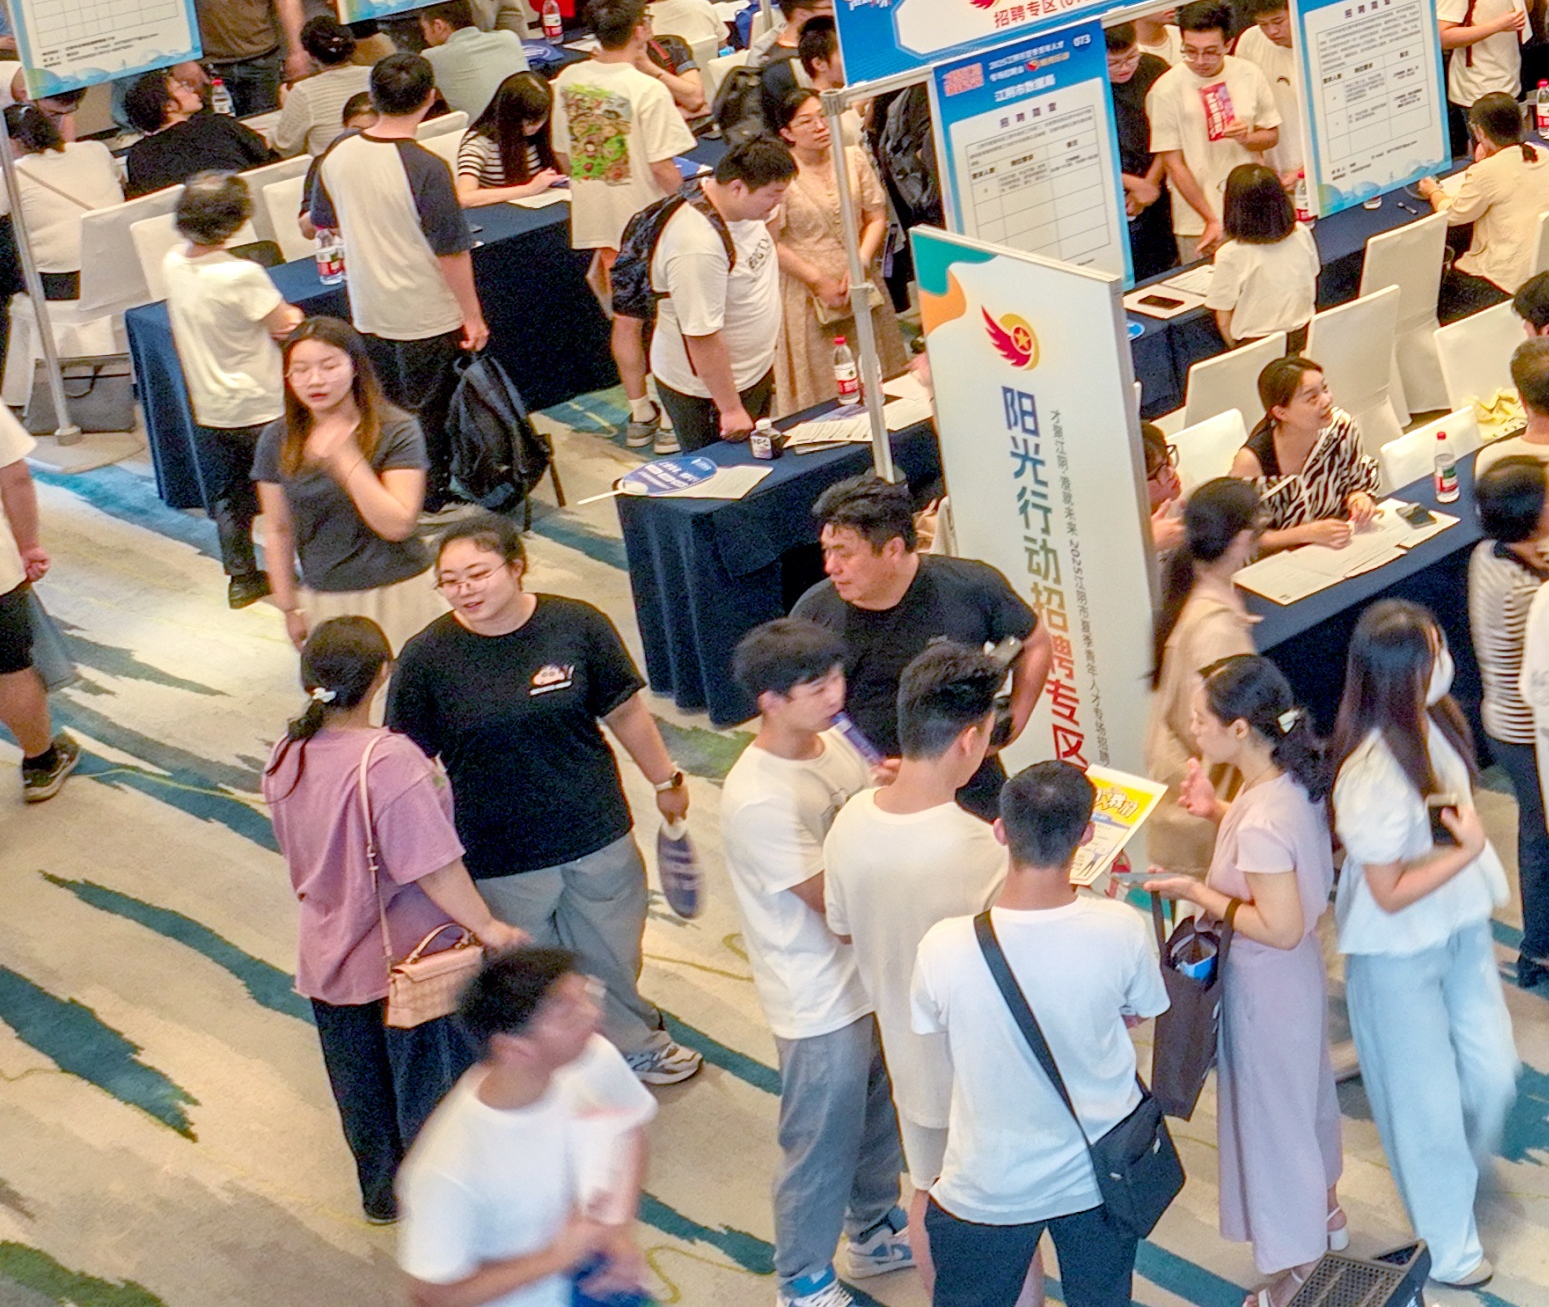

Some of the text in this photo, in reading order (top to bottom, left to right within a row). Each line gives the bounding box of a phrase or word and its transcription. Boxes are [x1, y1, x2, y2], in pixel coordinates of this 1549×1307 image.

[1072, 31, 1091, 48] 073
[1000, 385, 1088, 771] 阳光行动招聘专区
